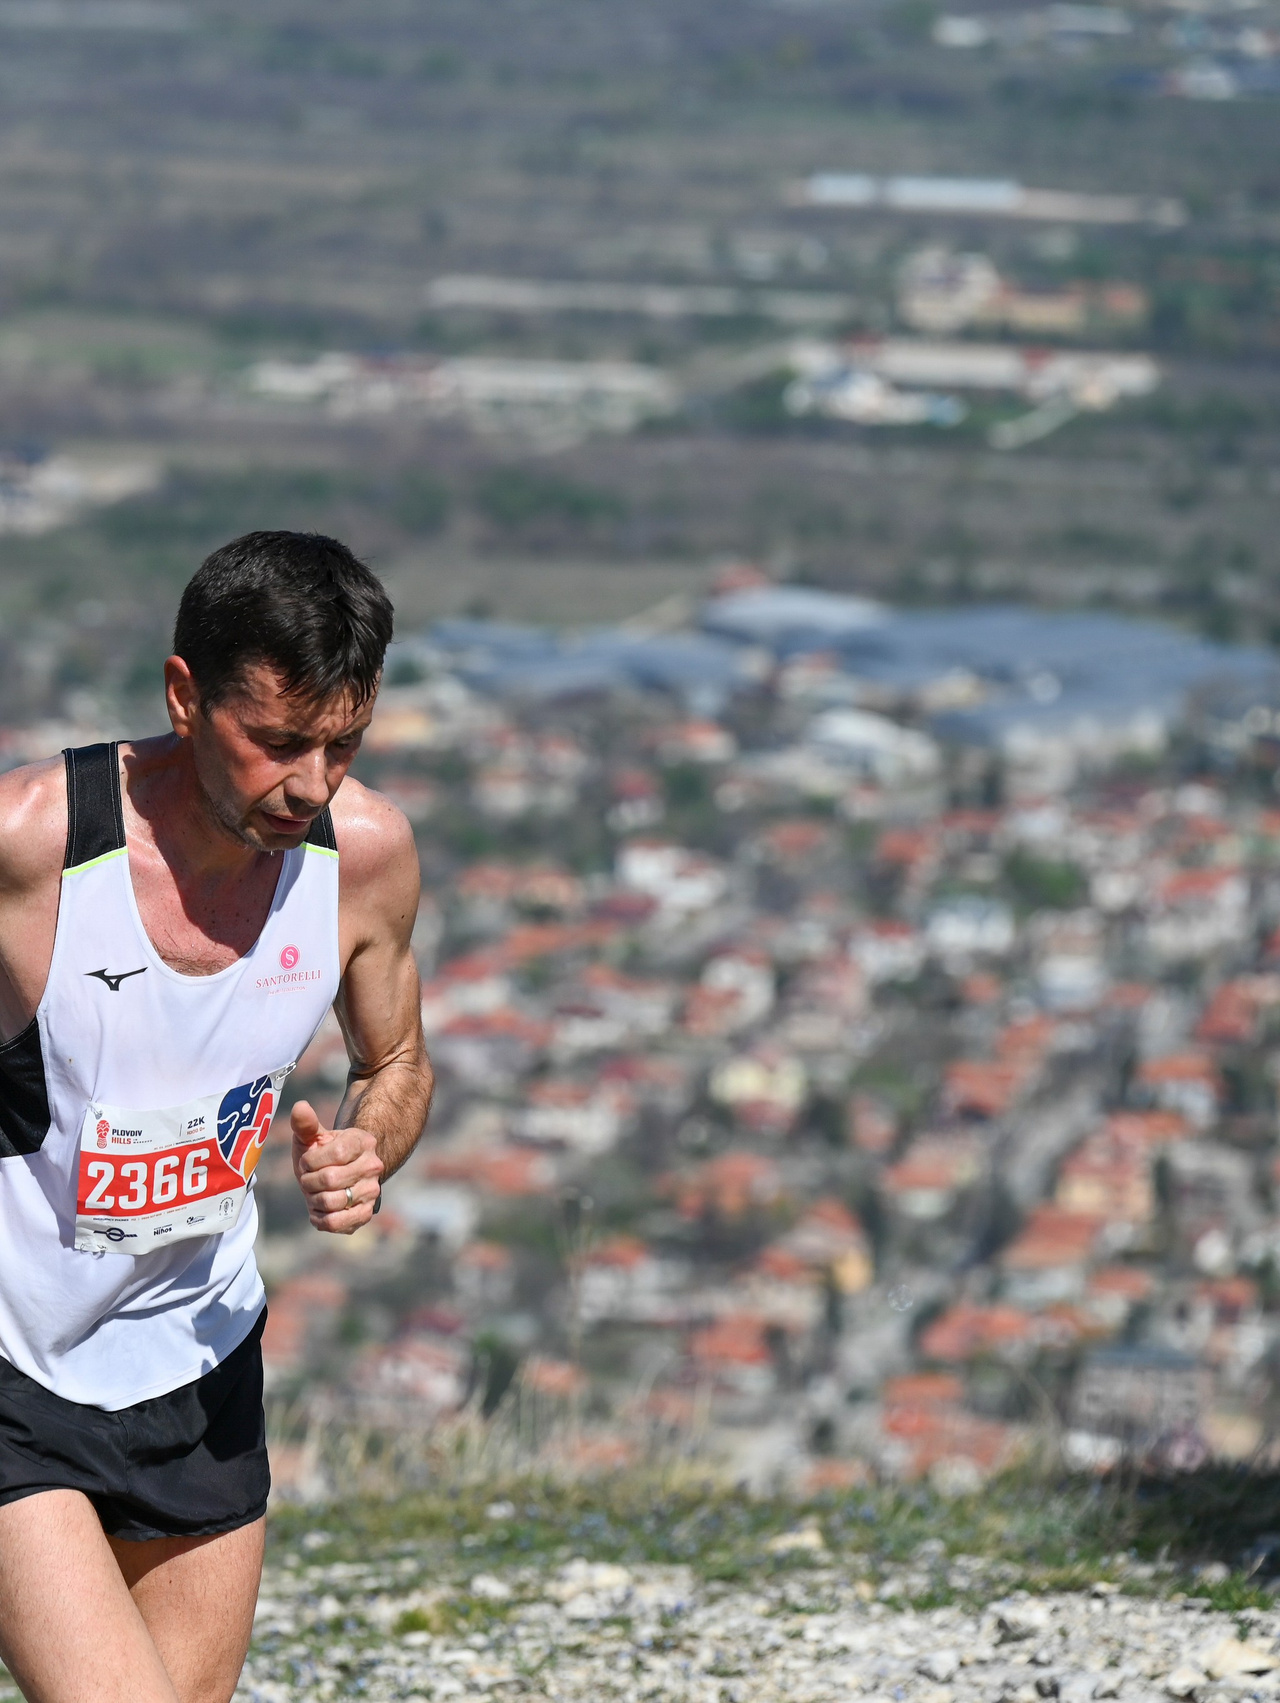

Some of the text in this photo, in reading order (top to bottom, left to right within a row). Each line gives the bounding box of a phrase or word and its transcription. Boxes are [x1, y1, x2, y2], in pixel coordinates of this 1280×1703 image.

[255, 969, 321, 989] SANTORELLI
[187, 1115, 205, 1129] 22K
[111, 1128, 143, 1137] PLOVDIV
[111, 1136, 132, 1144] HILLS
[85, 1148, 210, 1210] 2366
